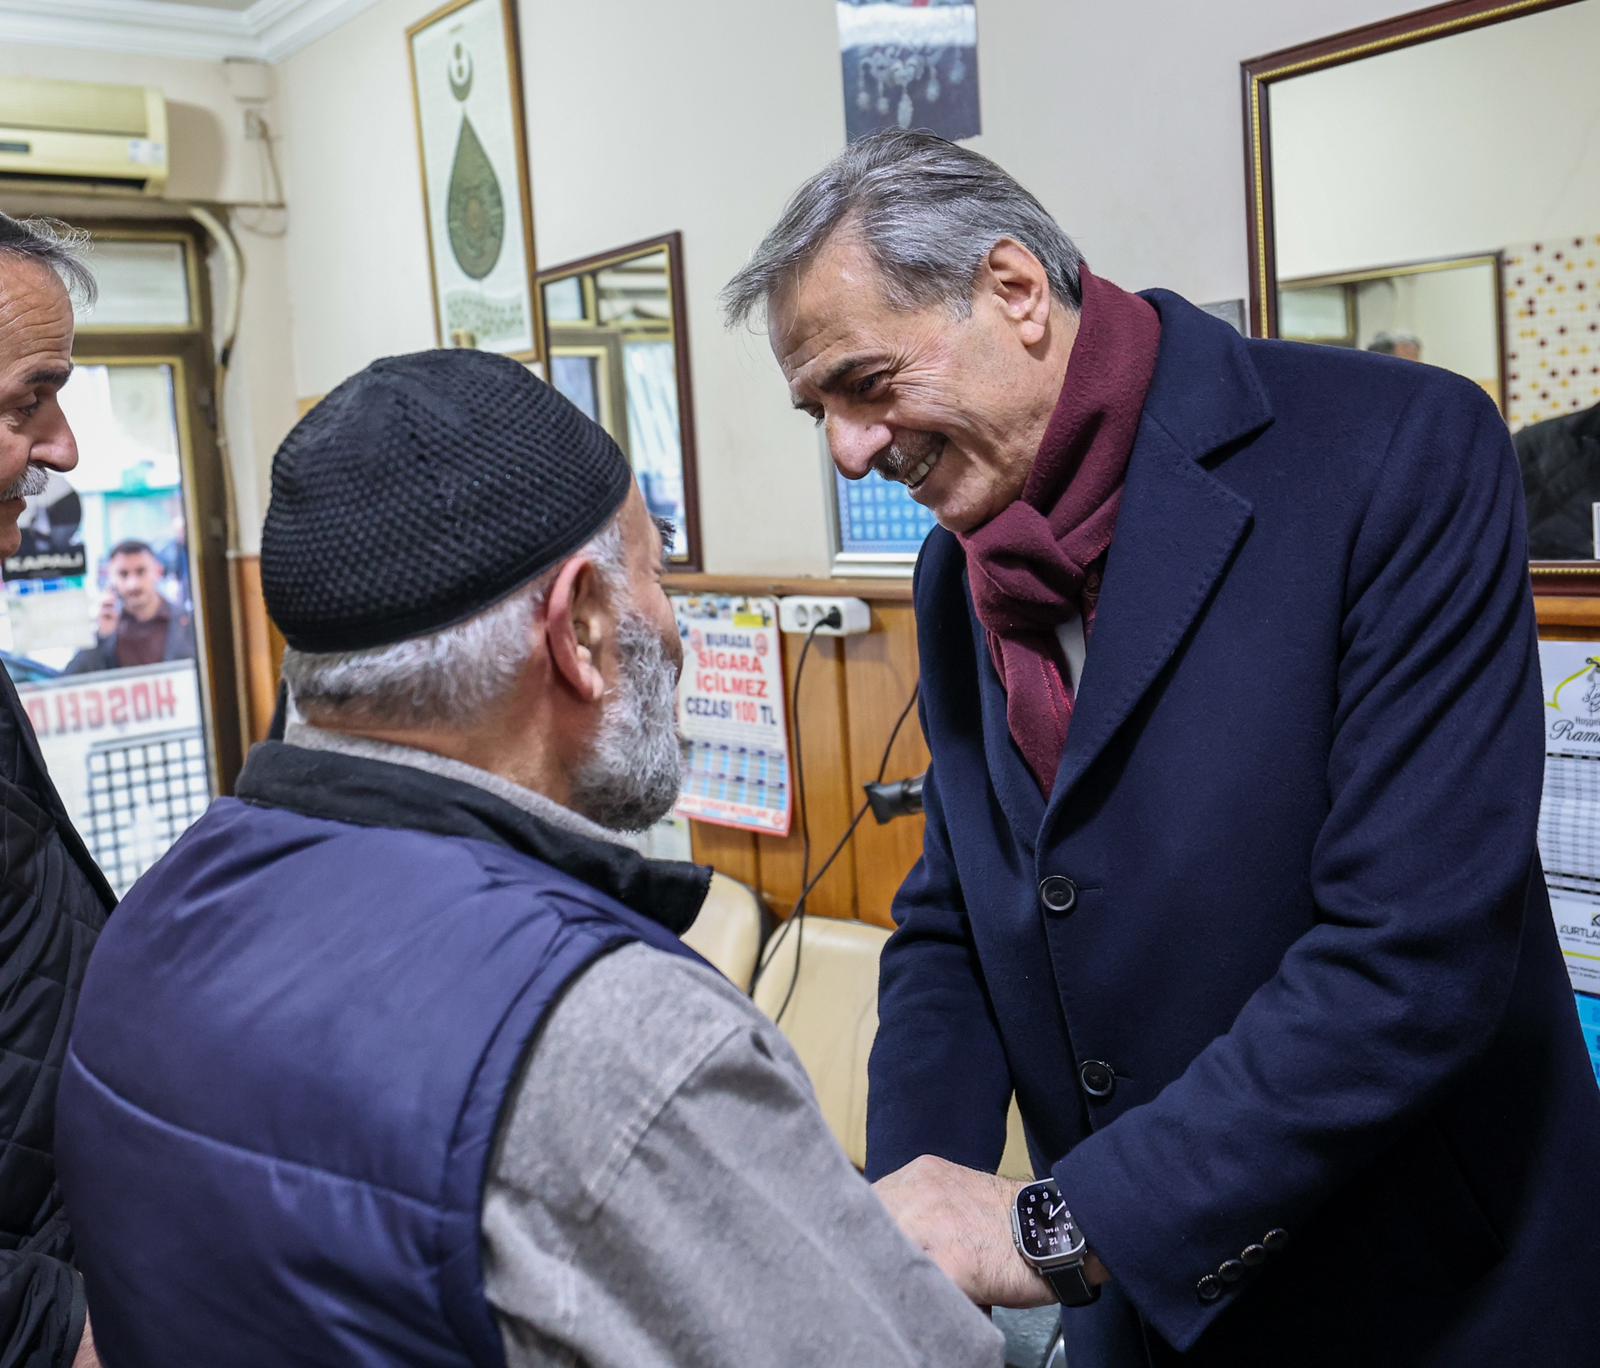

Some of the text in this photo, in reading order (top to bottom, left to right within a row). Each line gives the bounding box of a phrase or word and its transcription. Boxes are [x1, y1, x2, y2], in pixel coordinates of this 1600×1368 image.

[5, 552, 84, 573] KAPALI
[705, 632, 752, 649] BURADA
[697, 649, 764, 674] SİGARA
[696, 671, 769, 698] İÇİLMEZ
[686, 696, 777, 725] CEZASI 100 TL
[1029, 1194, 1036, 1202] 5
[1043, 1191, 1049, 1199] 6
[1065, 1210, 1071, 1218] 9
[1028, 1218, 1035, 1226] 3
[1063, 1222, 1073, 1230] 10
[1030, 1230, 1037, 1238] 2
[1062, 1234, 1071, 1242] 11
[1037, 1240, 1043, 1248] 1
[1048, 1237, 1058, 1245] 12
